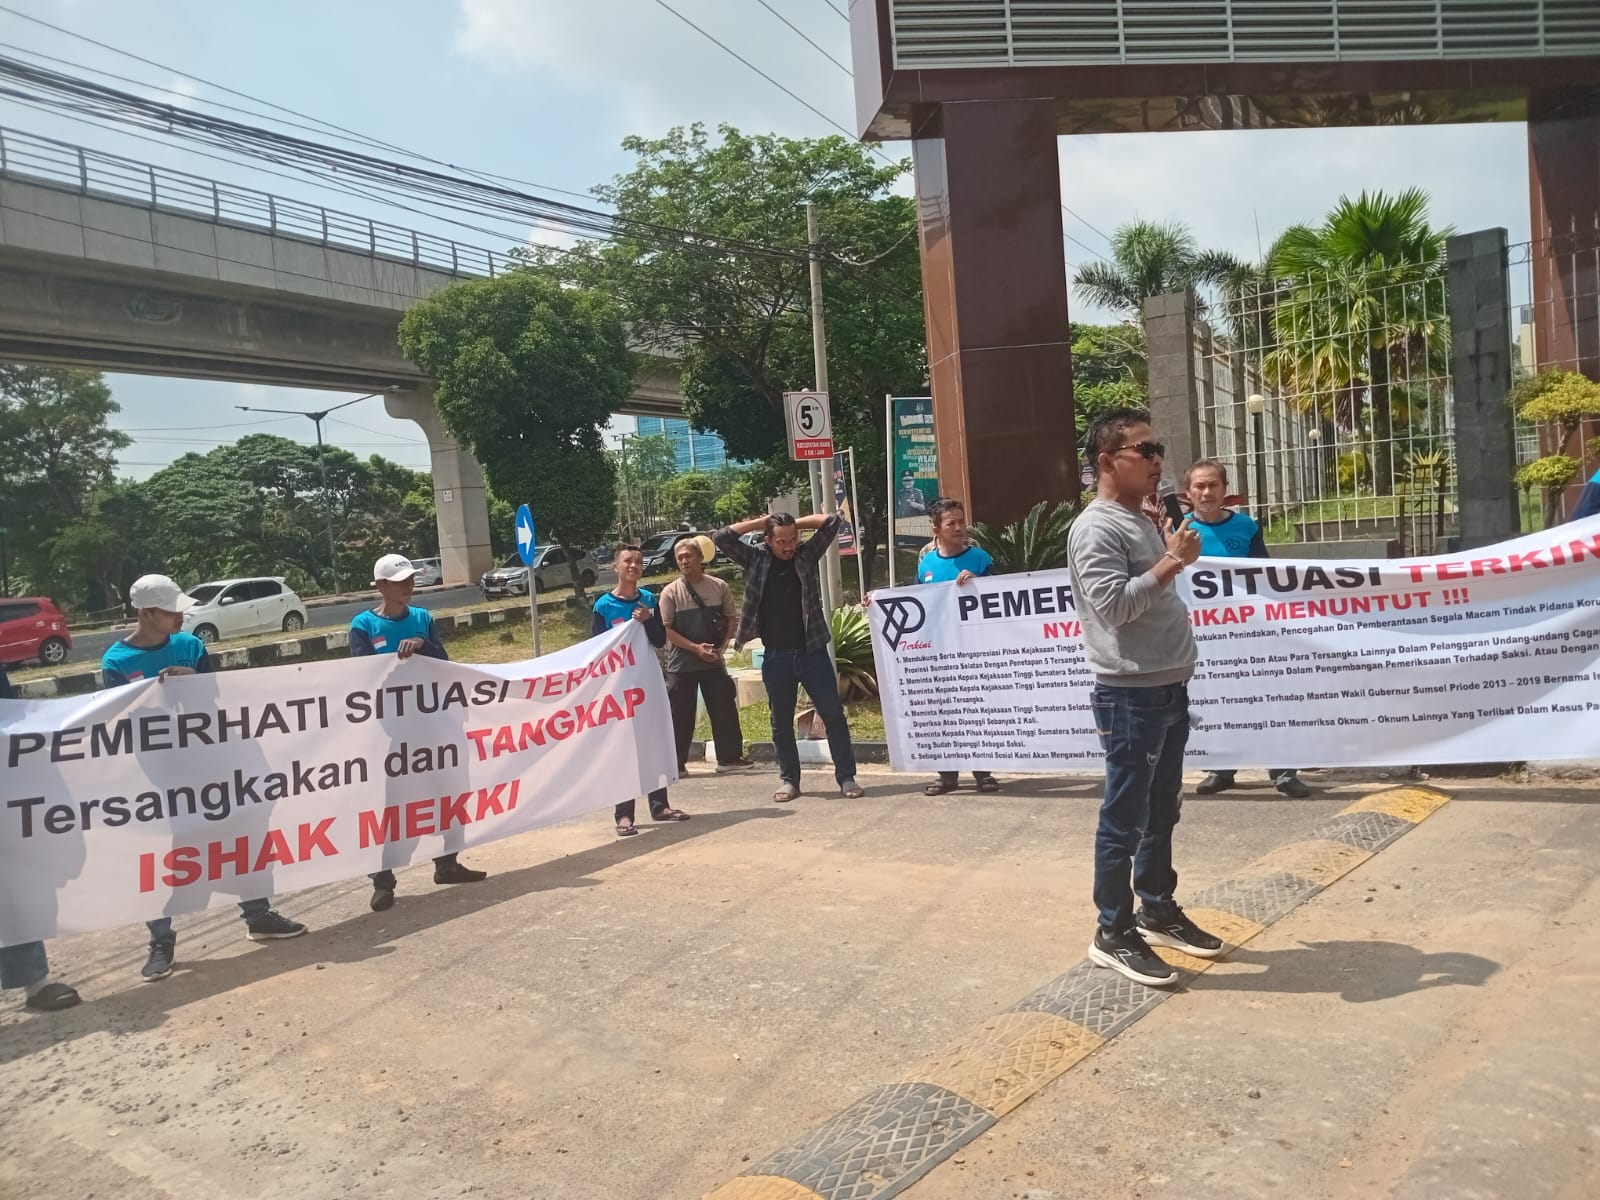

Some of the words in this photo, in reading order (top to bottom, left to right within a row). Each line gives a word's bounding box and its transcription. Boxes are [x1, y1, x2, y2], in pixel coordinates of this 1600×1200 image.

[801, 406, 813, 430] 5
[1192, 565, 1382, 599] SITUASI
[1229, 629, 1279, 639] Penindakan,
[1281, 624, 1334, 635] Pencegahan
[1337, 623, 1355, 631] Dan
[1357, 617, 1428, 629] Pemberantasan
[1430, 612, 1463, 623] Segala
[1465, 610, 1500, 619] Macam
[1502, 604, 1537, 616] Tindak
[1539, 601, 1574, 612] Pidana
[1265, 591, 1431, 621] MENUNTUT
[1442, 587, 1469, 606] !!!
[899, 640, 932, 652] Terkini
[1207, 657, 1247, 667] Tersangka
[1250, 656, 1265, 664] Dan
[1269, 655, 1287, 663] Atau
[1312, 650, 1358, 660] Tersangka
[1360, 647, 1396, 657] Lainnya
[1399, 645, 1427, 653] Dalam
[1431, 640, 1489, 651] Pelanggaran
[1492, 632, 1570, 645] Undang-undang
[1208, 670, 1249, 679] Tersangka
[1252, 668, 1284, 677] Lainnya
[1286, 666, 1313, 675] Dalam
[1316, 662, 1383, 673] Pengembangan
[1385, 657, 1451, 668] Pemeriksaaan
[1454, 653, 1499, 663] Terhadap
[1502, 650, 1531, 660] Saksi.
[1535, 647, 1557, 656] Atau
[1561, 643, 1599, 654] Dengan
[8, 695, 329, 768] PEMERHATI
[345, 679, 510, 724] SITUASI
[522, 642, 636, 700] TERKINI
[1221, 695, 1263, 704] Tersangka
[1265, 693, 1304, 702] Terhadap
[1307, 690, 1339, 700] Mantan
[1341, 689, 1365, 698] Wakil
[1368, 687, 1410, 696] Gubernur
[1413, 684, 1446, 694] Sumsel
[1450, 682, 1480, 692] Priode
[1483, 679, 1507, 689] 2013
[1517, 677, 1541, 686] 2019
[1544, 673, 1590, 684] Bernama
[1224, 721, 1268, 731] Memanggil
[1271, 720, 1286, 728] Dan
[1289, 718, 1335, 727] Memeriksa
[1338, 717, 1368, 726] Oknum
[1378, 715, 1410, 724] Oknum
[1413, 713, 1448, 722] Lainnya
[1451, 710, 1475, 719] Yang
[1477, 708, 1514, 718] Terlibat
[1517, 705, 1548, 715] Dalam
[1552, 703, 1583, 712] Kasus
[6, 756, 368, 838] Tersangkakan
[384, 742, 459, 778] dan
[466, 687, 646, 761] TANGKAP
[138, 816, 339, 893] ISHAK
[358, 778, 521, 850] MEKKI
